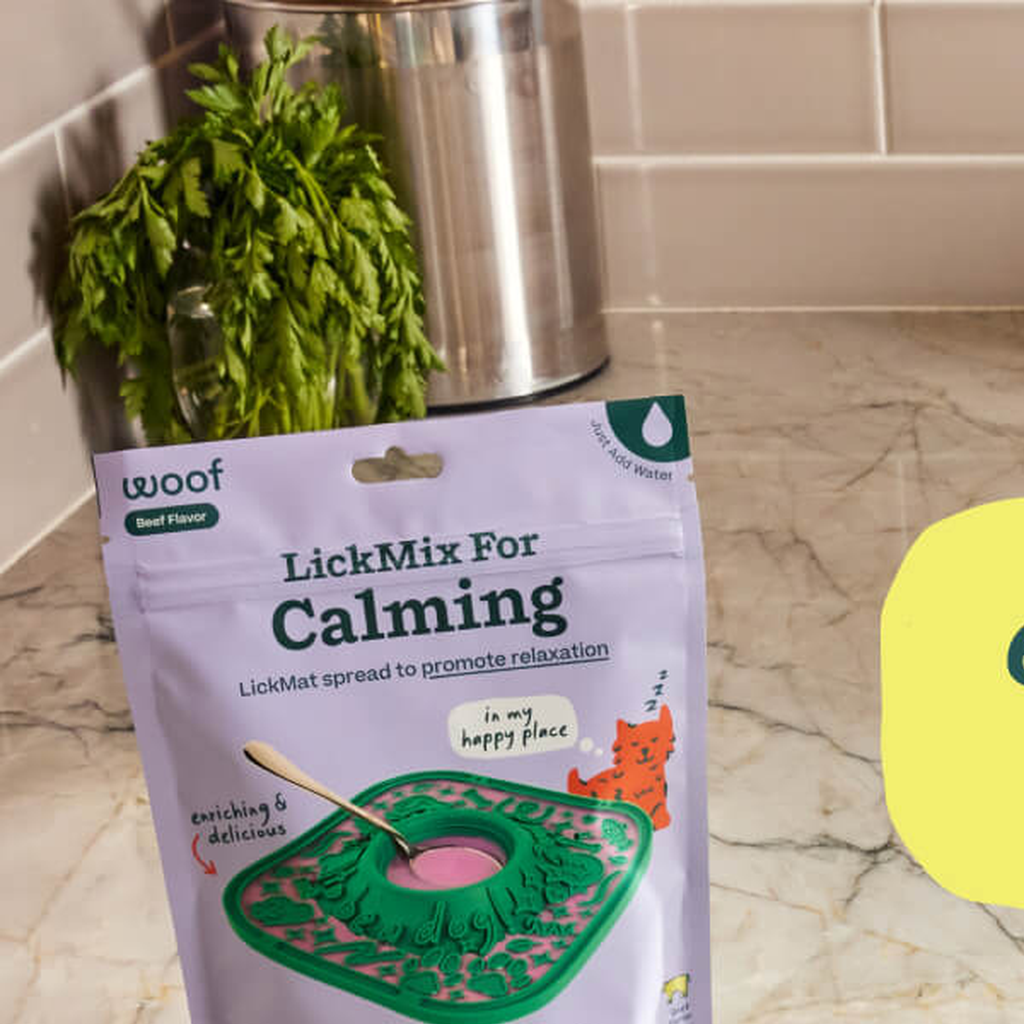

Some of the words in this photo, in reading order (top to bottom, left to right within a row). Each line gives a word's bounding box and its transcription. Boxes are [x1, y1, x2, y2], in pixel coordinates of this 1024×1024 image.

[590, 419, 610, 448] Just
[609, 449, 632, 469] Add
[634, 464, 672, 481] Water
[123, 458, 223, 499] woof
[136, 515, 165, 529] Beef
[167, 510, 207, 526] Flavor
[281, 536, 462, 583] LickMix
[469, 531, 539, 562] For
[271, 576, 568, 650] Calming
[239, 674, 318, 697] LickMat
[321, 664, 392, 690] spread
[395, 660, 417, 678] to
[421, 651, 507, 678] promote
[510, 641, 609, 665] relaxation
[485, 706, 500, 723] in
[507, 707, 533, 727] my
[461, 729, 515, 751] happy
[522, 721, 569, 747] place
[191, 800, 270, 827] enriching
[275, 792, 287, 811] &
[208, 823, 286, 844] delicious
